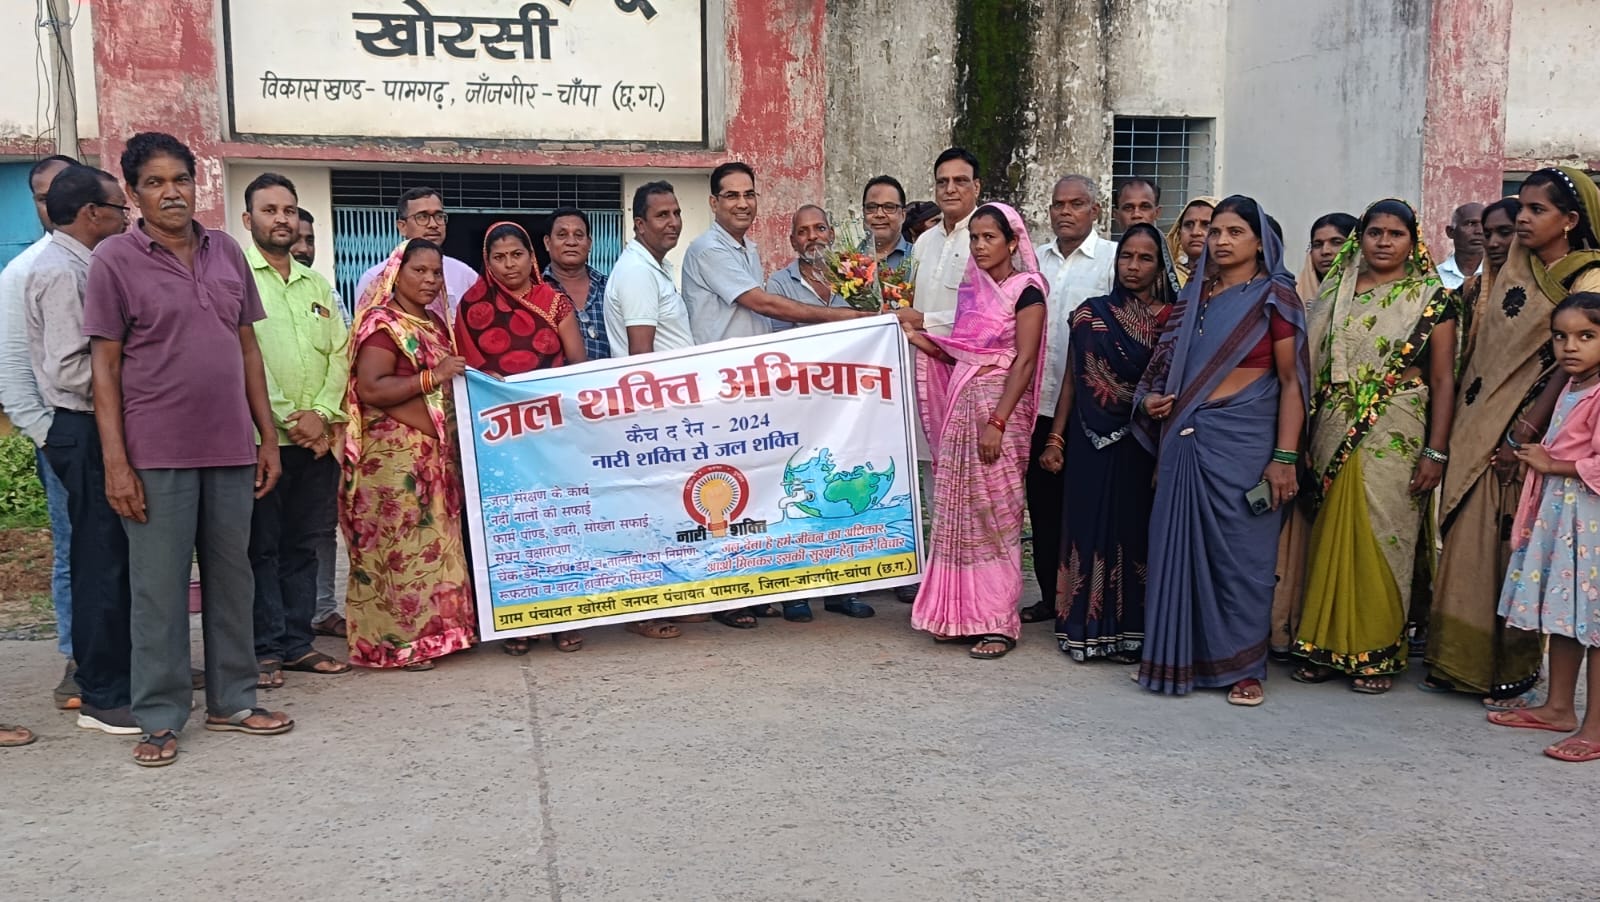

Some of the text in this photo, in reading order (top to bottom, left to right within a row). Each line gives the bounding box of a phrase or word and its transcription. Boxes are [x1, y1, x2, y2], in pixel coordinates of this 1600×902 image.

[352, 0, 558, 59] खोरसी
[480, 352, 892, 440] जल शक्ति अभियान
[626, 424, 658, 443] कैच
[665, 425, 677, 441] द
[681, 417, 704, 437] रैन
[729, 413, 770, 432] 2024
[591, 431, 799, 468] नारी शक्ति से जल शक्ति
[490, 495, 509, 505] जल
[514, 490, 546, 503] संरक्षण
[552, 486, 562, 498] के
[491, 512, 509, 525] नदी
[543, 507, 557, 518] की
[562, 501, 591, 515] सफाई
[620, 514, 648, 528] सफाई
[676, 518, 767, 543] नारी शक्ति
[765, 536, 773, 548] है
[828, 530, 840, 539] का
[497, 569, 518, 581] चेक
[647, 552, 660, 561] का
[499, 612, 522, 625] ग्राम
[530, 607, 572, 620] पंचायत
[578, 599, 616, 614] खोरसी
[623, 595, 658, 609] जनपद
[663, 589, 704, 603] पंचायत
[711, 584, 753, 597] पामगढ़,
[877, 559, 913, 577] (छ.ग.)
[543, 585, 551, 594] व
[556, 581, 579, 592] वाटर
[630, 570, 662, 583] सिस्टम
